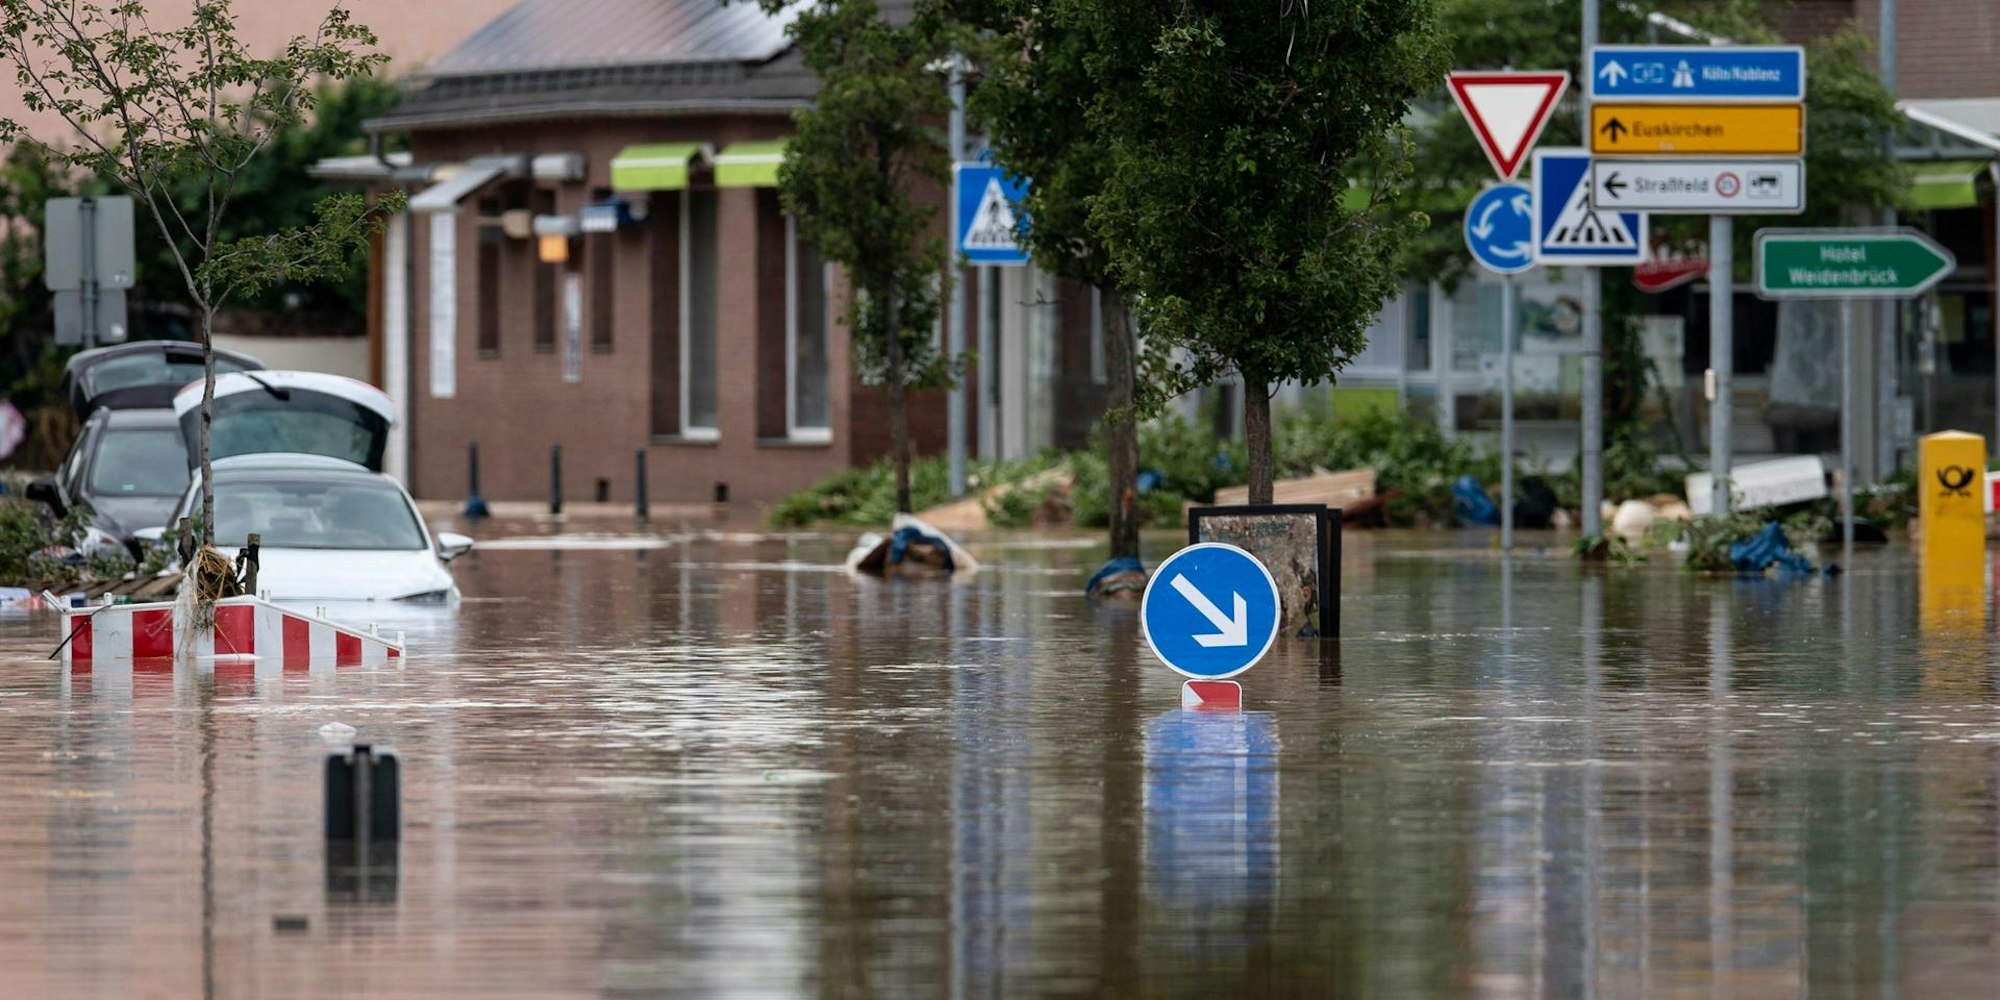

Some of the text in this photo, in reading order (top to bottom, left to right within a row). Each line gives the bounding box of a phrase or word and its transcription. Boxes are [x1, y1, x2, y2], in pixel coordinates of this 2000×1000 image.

[1633, 122, 1723, 136] Euskirchen
[1635, 177, 1708, 192] Straßfeld
[1821, 246, 1865, 262] Hotel
[1789, 268, 1897, 284] Weidenbrück
